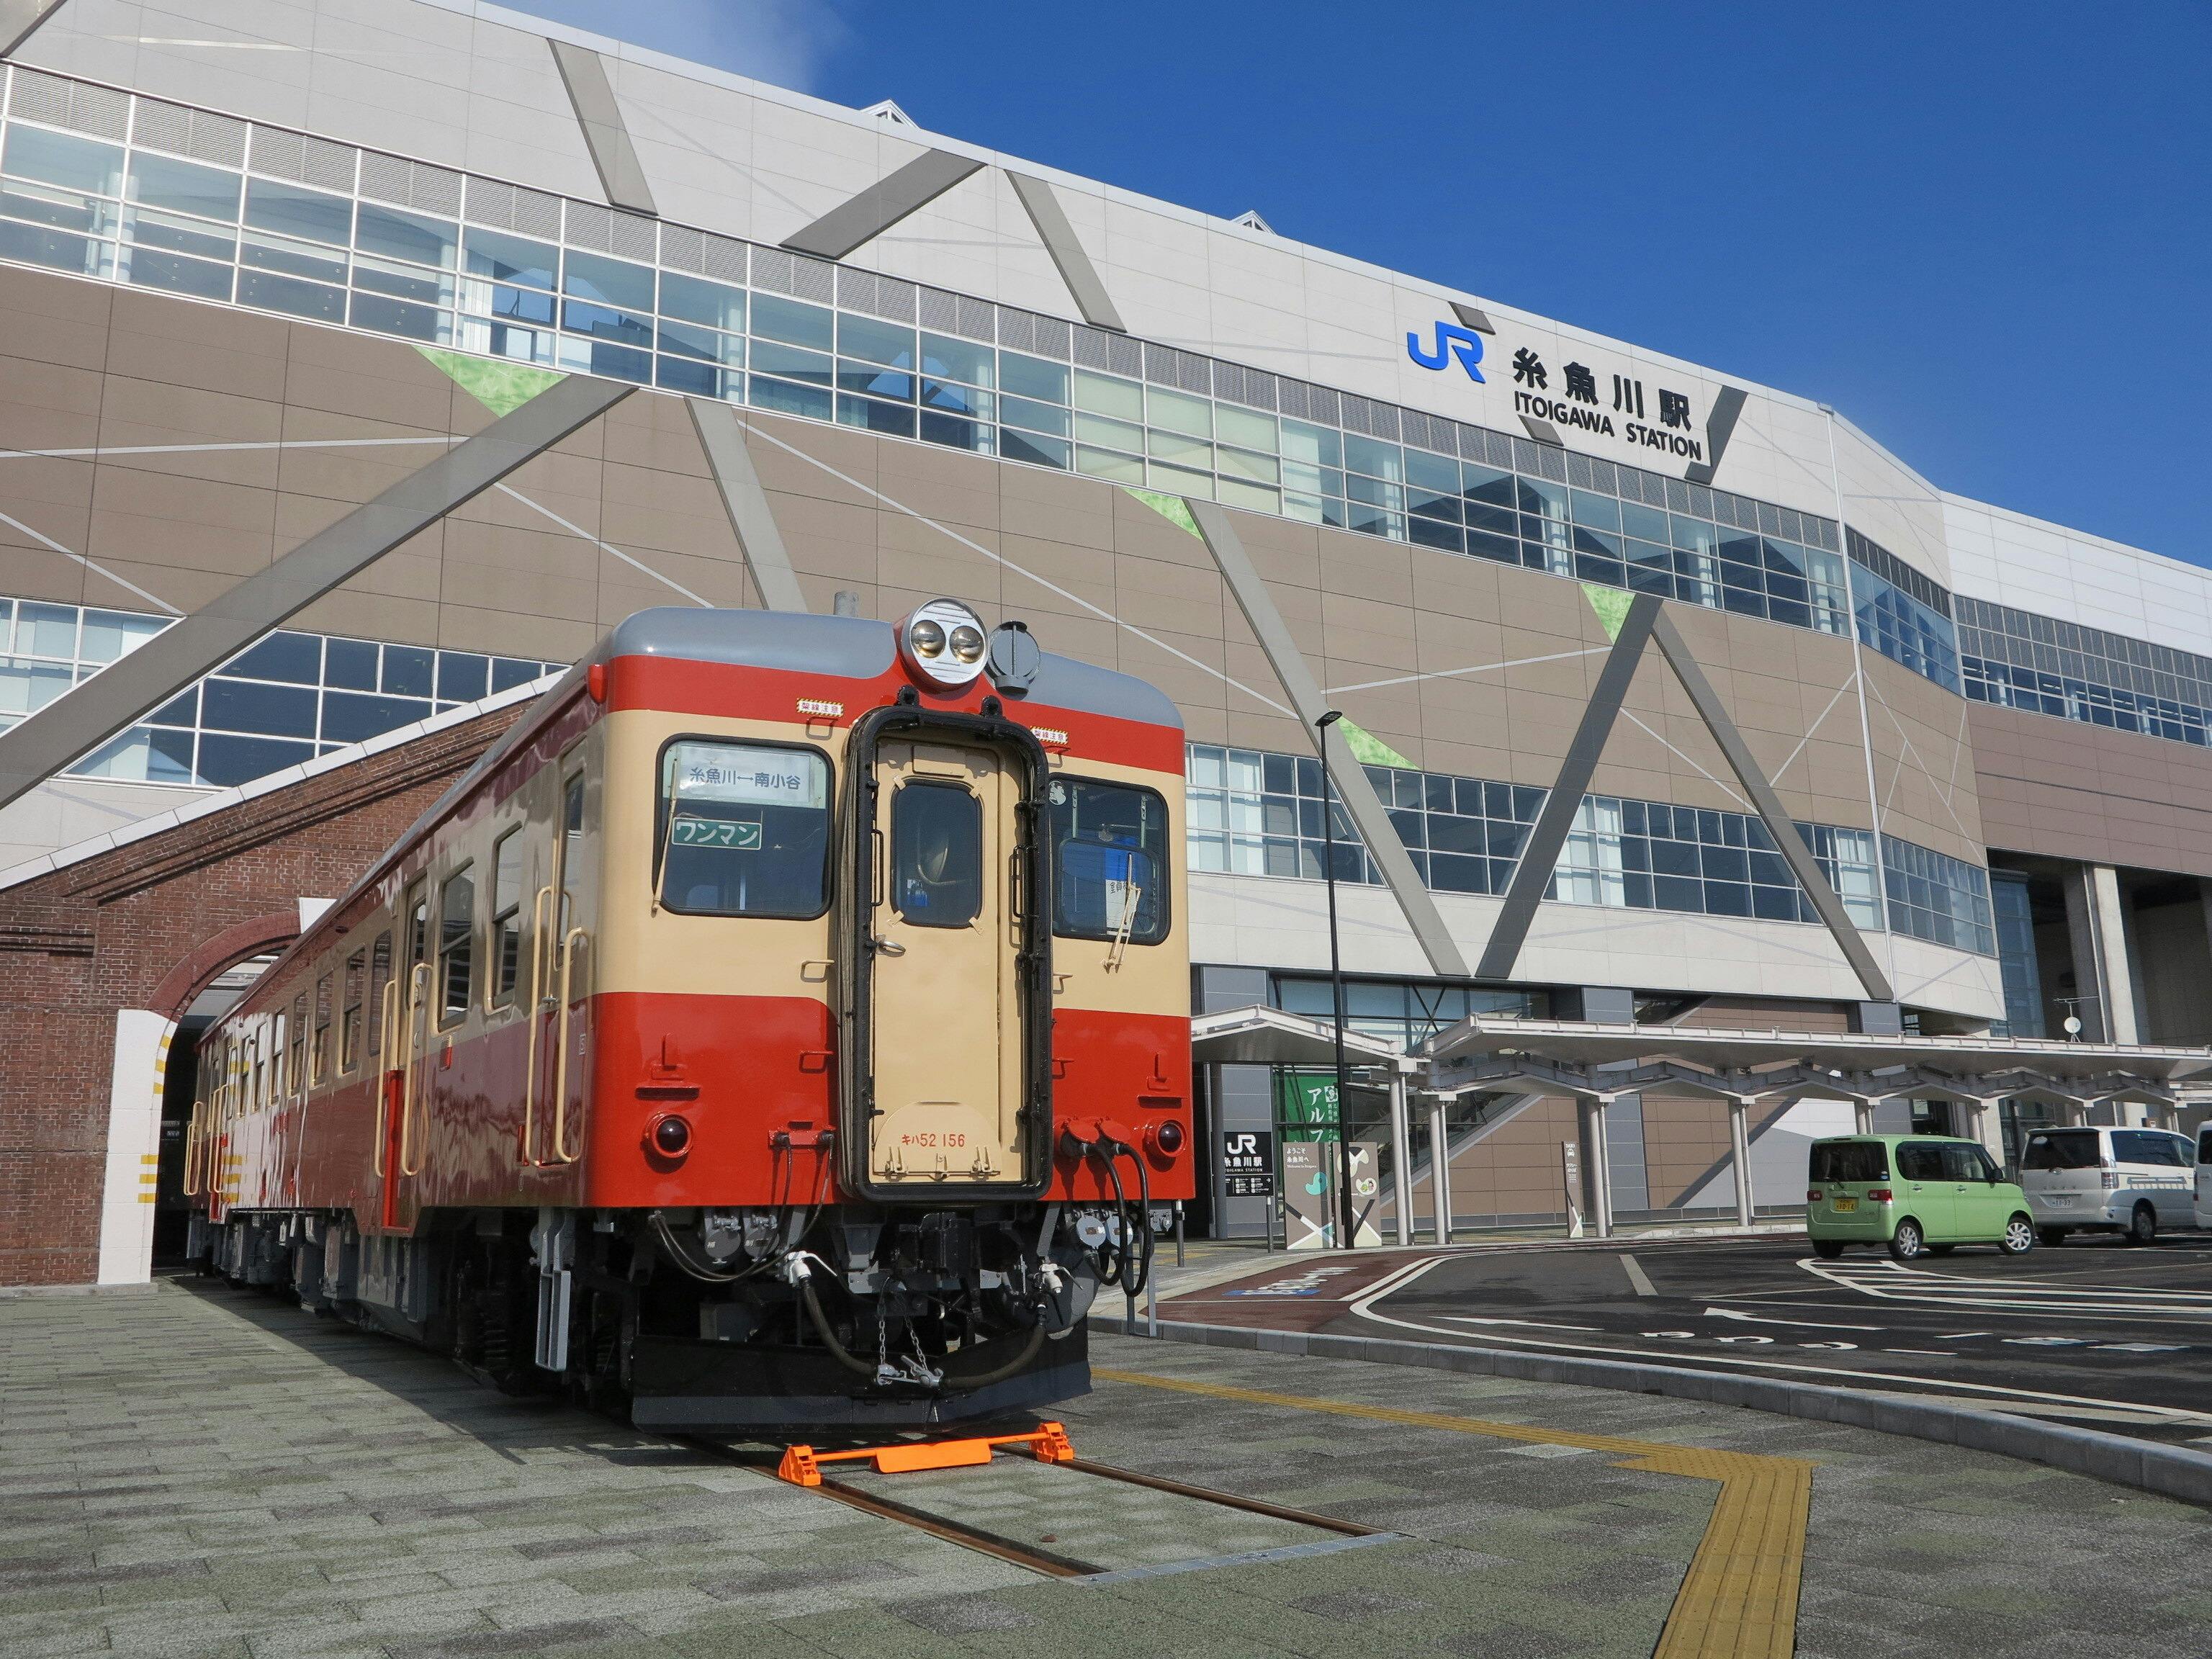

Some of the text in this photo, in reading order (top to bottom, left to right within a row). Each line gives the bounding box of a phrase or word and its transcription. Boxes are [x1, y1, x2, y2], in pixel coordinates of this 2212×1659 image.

[1407, 320, 1485, 384] JR
[1512, 347, 1692, 432] 糸魚川駅
[1514, 390, 1701, 461] ITOIGAWA STATION
[676, 821, 758, 845] ワンマン
[902, 1133, 966, 1147] キハ52 156
[1227, 1134, 1256, 1154] JR
[1224, 1156, 1262, 1167] 糸魚川駅
